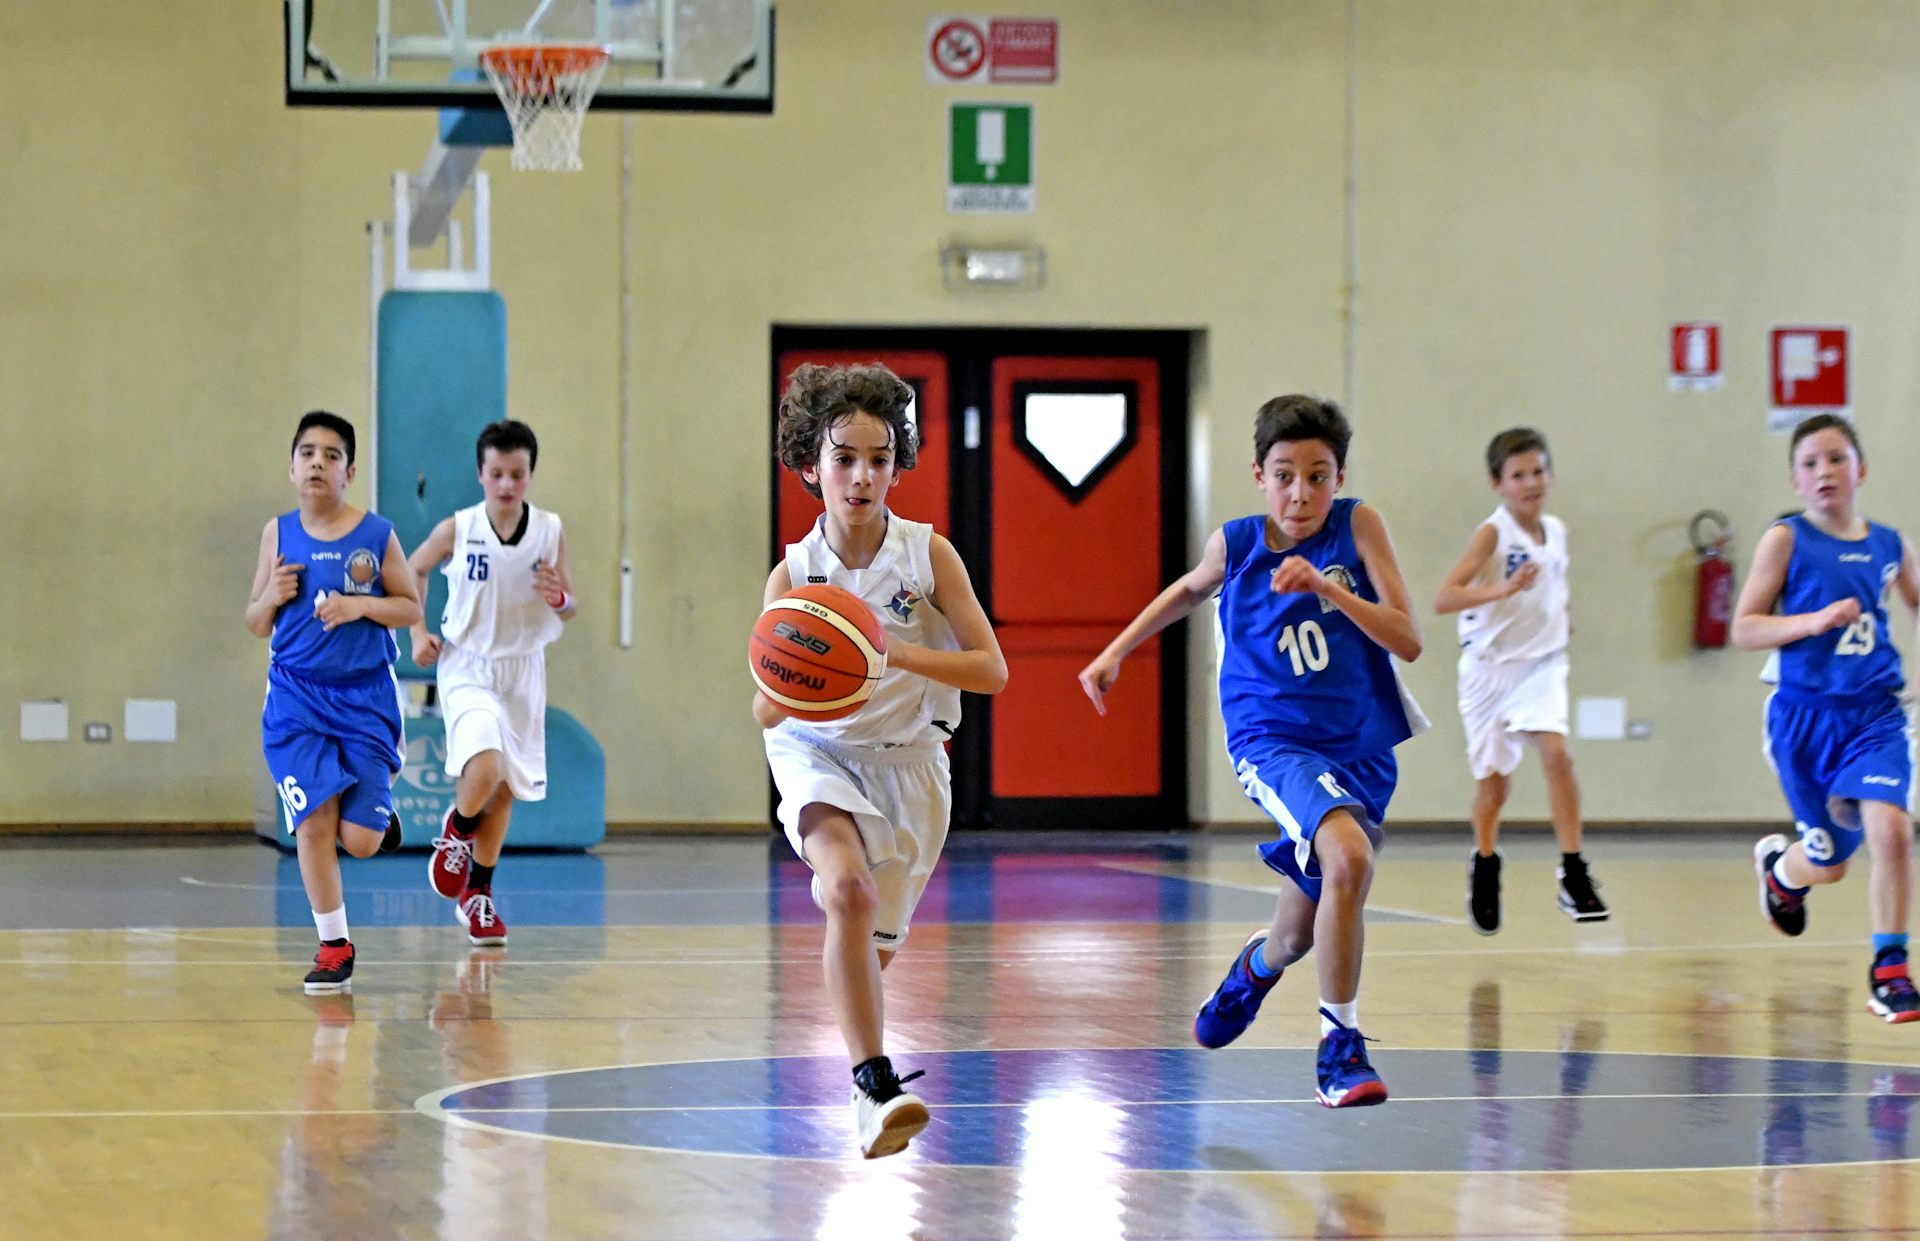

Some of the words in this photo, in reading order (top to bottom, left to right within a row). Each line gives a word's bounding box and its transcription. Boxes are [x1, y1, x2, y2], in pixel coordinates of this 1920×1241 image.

[467, 553, 489, 581] 25
[1277, 619, 1330, 677] 10
[1834, 612, 1876, 657] 29
[760, 654, 827, 691] molten
[278, 775, 308, 817] 16
